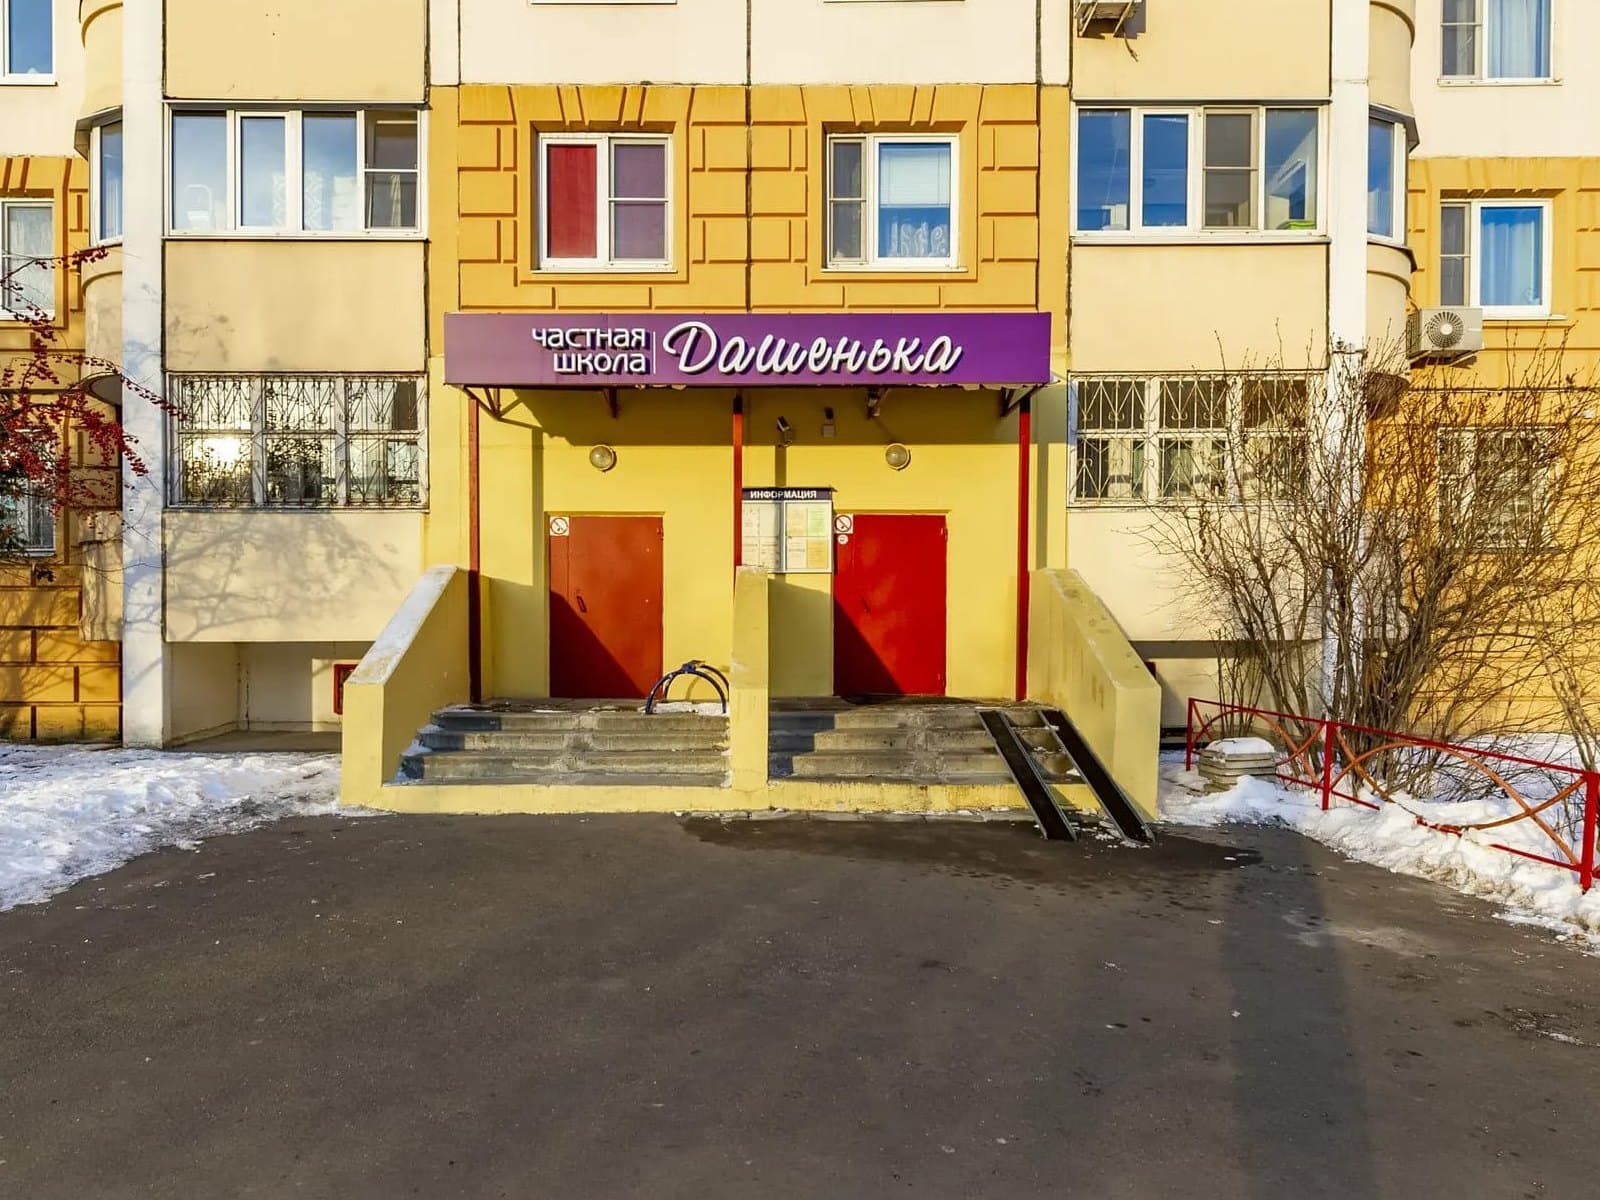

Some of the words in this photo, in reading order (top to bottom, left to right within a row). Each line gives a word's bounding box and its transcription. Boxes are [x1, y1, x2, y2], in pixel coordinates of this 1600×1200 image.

[531, 327, 646, 347] частная
[662, 320, 962, 374] Дашенька
[553, 352, 646, 373] школа
[750, 490, 817, 499] ИНФОРМАЦИЯ
